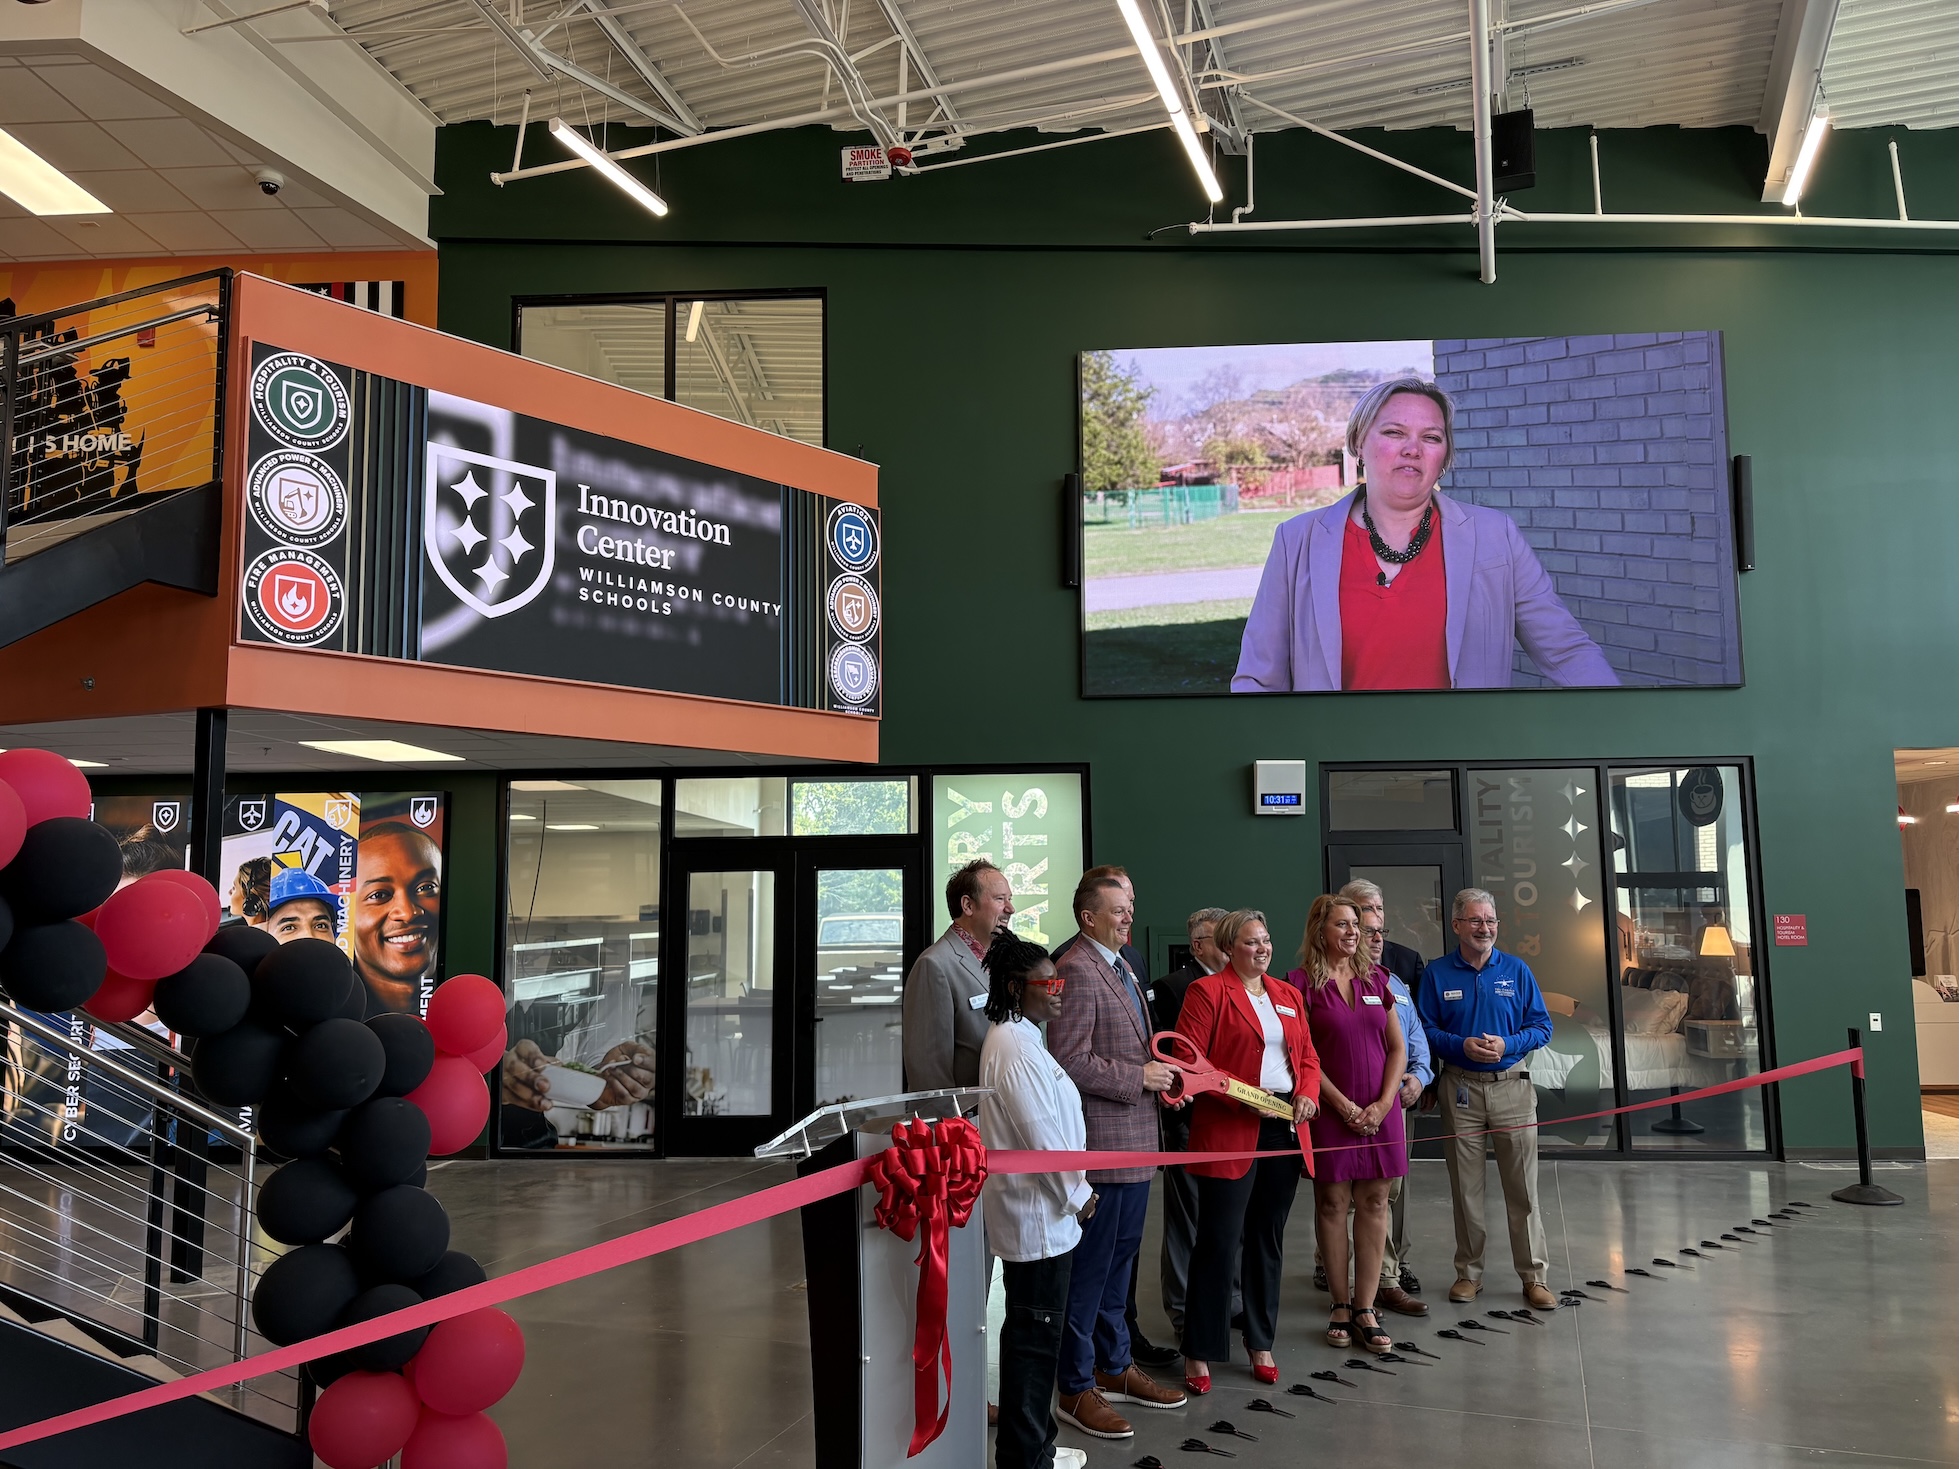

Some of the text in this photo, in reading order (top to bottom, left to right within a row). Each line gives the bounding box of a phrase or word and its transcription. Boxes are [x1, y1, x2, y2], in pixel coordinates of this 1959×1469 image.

[849, 159, 885, 167] PARTITION
[850, 149, 882, 161] SMOKE
[255, 356, 347, 419] HOSPITALITY & TOURISM
[62, 433, 132, 453] HOME
[257, 402, 344, 447] WILLIAMSON COUNTY SCHOOLS
[253, 454, 344, 516] ADVANCED POWER & MACHINERY
[254, 501, 341, 543] WILLIAMSON COUNTY SCHOOLS
[577, 483, 732, 547] Innovation
[837, 506, 869, 522] AVIATION
[577, 524, 676, 571] Center
[248, 551, 341, 600] FIRE MANAGEMENT
[579, 566, 781, 617] WILLIAMSON COUNTY
[829, 580, 843, 611] ADVANCED
[842, 576, 861, 584] POWER
[863, 583, 877, 620] MACHINERY
[250, 600, 338, 641] WILLIAMSON COUNTY SCHOOLS
[578, 587, 673, 616] SCHOOLS
[1264, 795, 1286, 805] 10:31
[272, 809, 336, 877] CAT
[1507, 776, 1540, 925] TOURISM
[336, 834, 353, 934] MACHINERY
[1001, 787, 1050, 945] ARTS
[1775, 915, 1791, 924] 130
[63, 1084, 80, 1142] CYBER
[1236, 1086, 1287, 1112] GRAND OPENING
